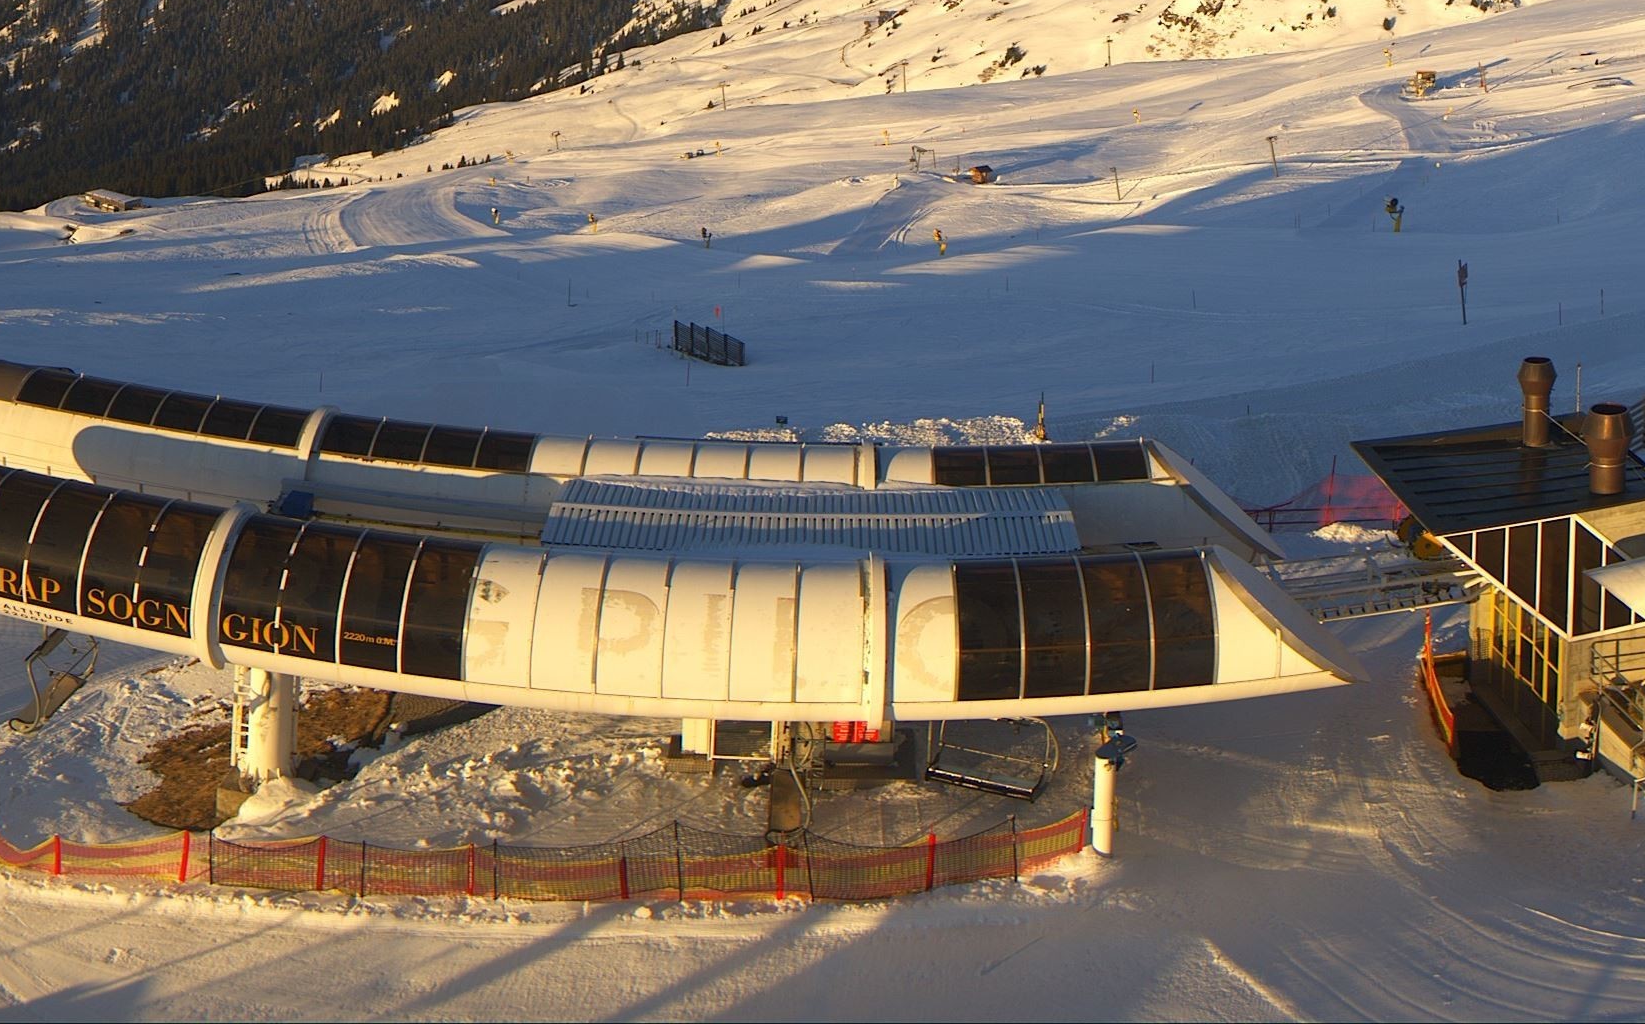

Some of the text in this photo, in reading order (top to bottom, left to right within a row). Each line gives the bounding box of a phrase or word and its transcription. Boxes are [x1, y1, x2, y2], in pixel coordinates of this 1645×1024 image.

[3, 603, 74, 625] ALTITUDE
[87, 587, 190, 633] SOGN
[222, 613, 320, 655] GION
[343, 631, 366, 642] 2220
